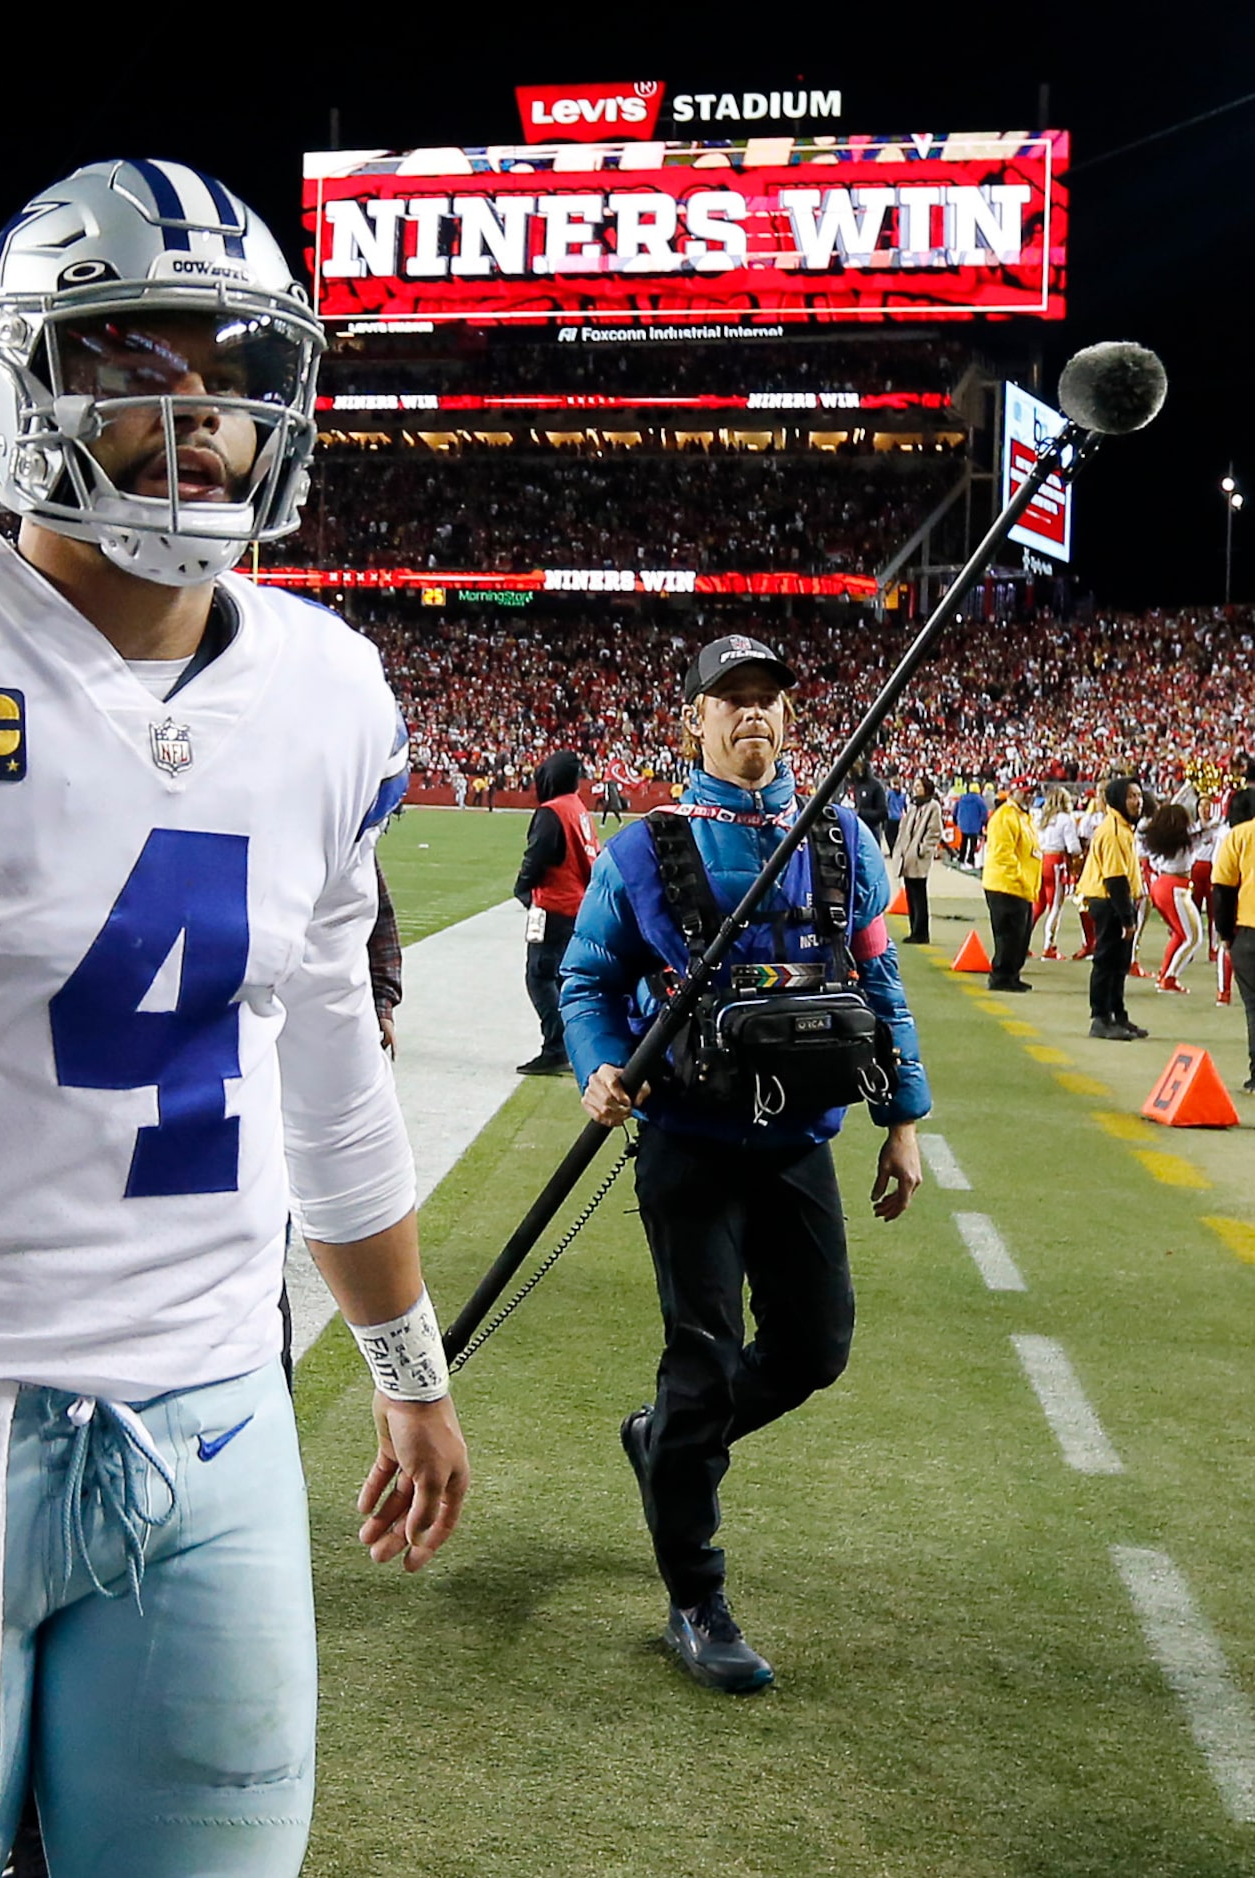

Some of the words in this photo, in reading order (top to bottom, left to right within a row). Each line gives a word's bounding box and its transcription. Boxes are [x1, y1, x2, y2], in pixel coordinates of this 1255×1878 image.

[672, 90, 842, 123] STADIUM
[322, 191, 748, 278] NINERS
[780, 184, 1032, 270] WIN
[581, 326, 647, 342] Foxconn
[649, 324, 721, 341] Industrial
[746, 392, 817, 409] NINERS
[818, 392, 860, 408] WIN
[544, 569, 636, 592] NINERS
[638, 569, 696, 592] WIN
[161, 743, 188, 764] NFL
[49, 828, 251, 1199] 4
[1153, 1054, 1193, 1111] G
[361, 1336, 400, 1392] FAITH
